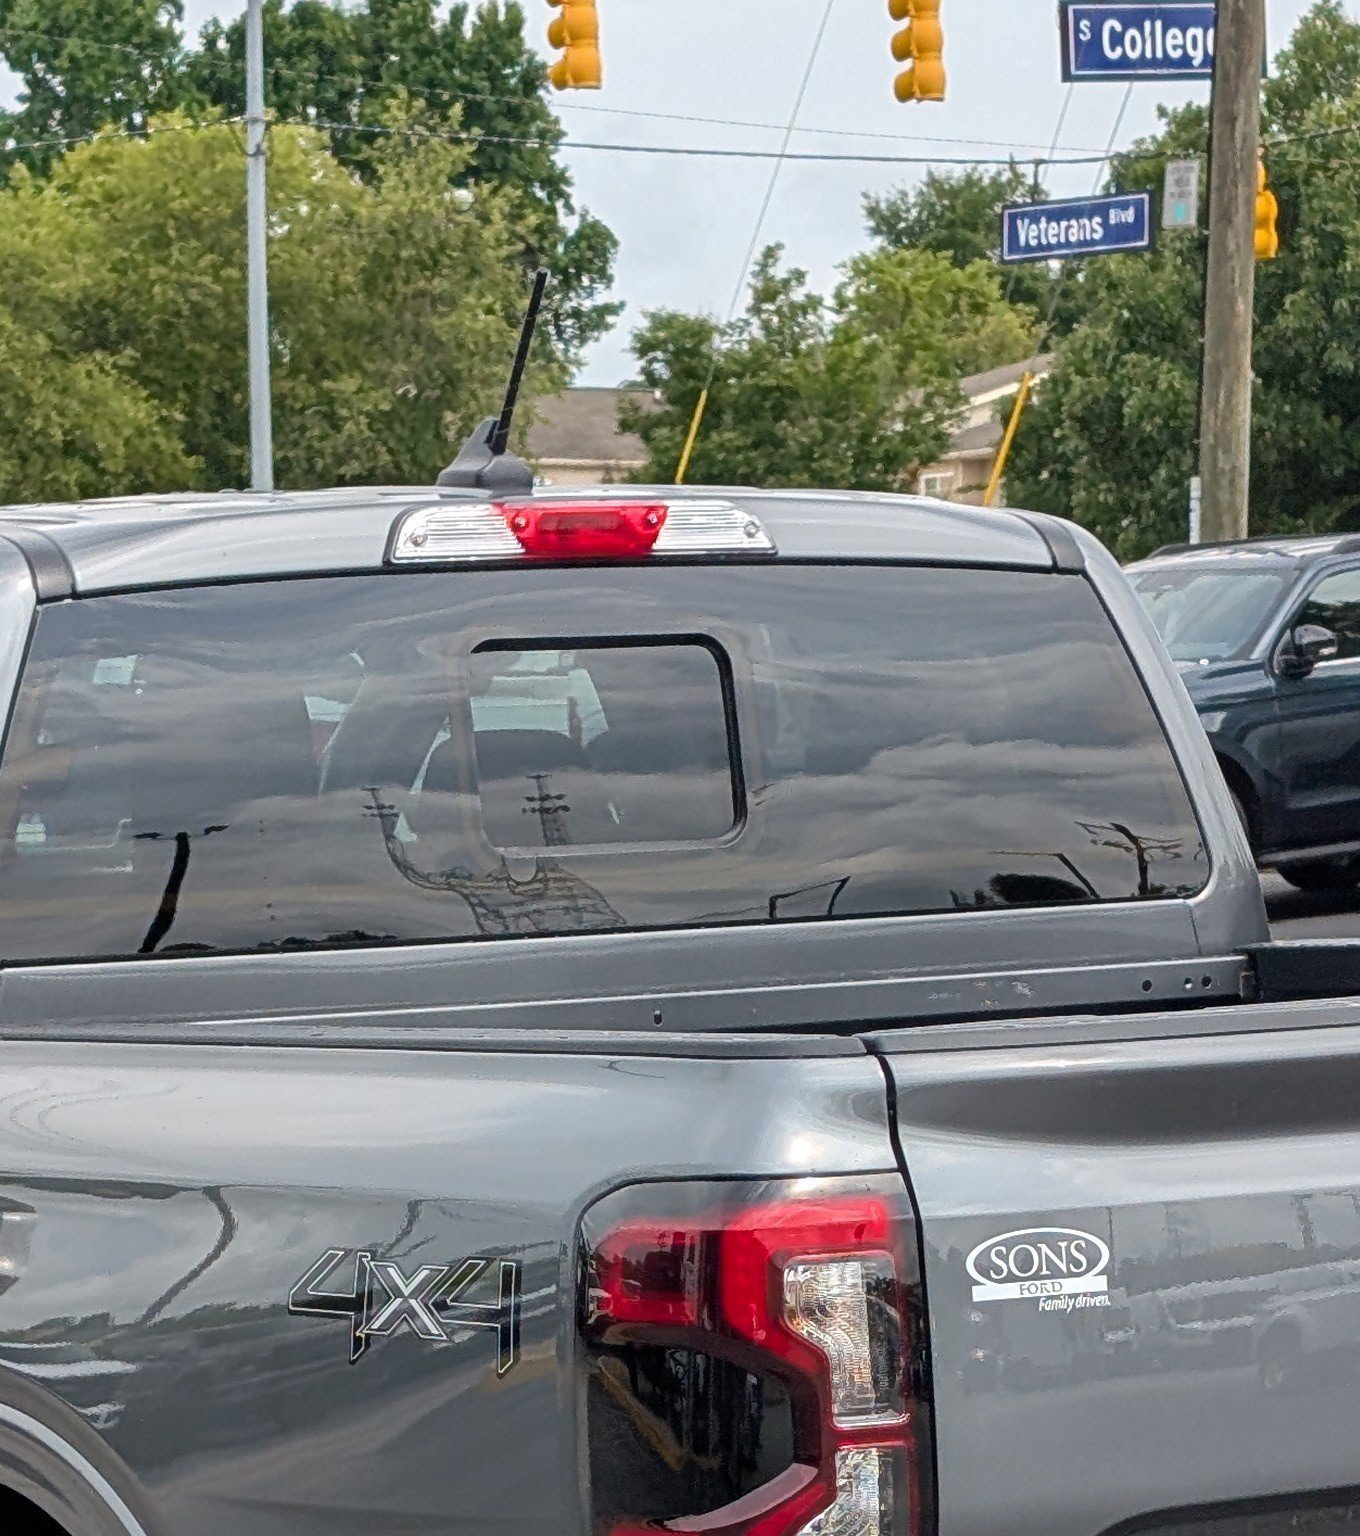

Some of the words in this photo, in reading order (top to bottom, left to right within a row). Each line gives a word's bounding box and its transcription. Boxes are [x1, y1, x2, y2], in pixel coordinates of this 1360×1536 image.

[1078, 18, 1092, 42] S
[1016, 216, 1104, 247] Veterans
[1108, 206, 1135, 225] Blvd
[989, 1239, 1088, 1280] SONS
[1019, 1281, 1063, 1296] FORD
